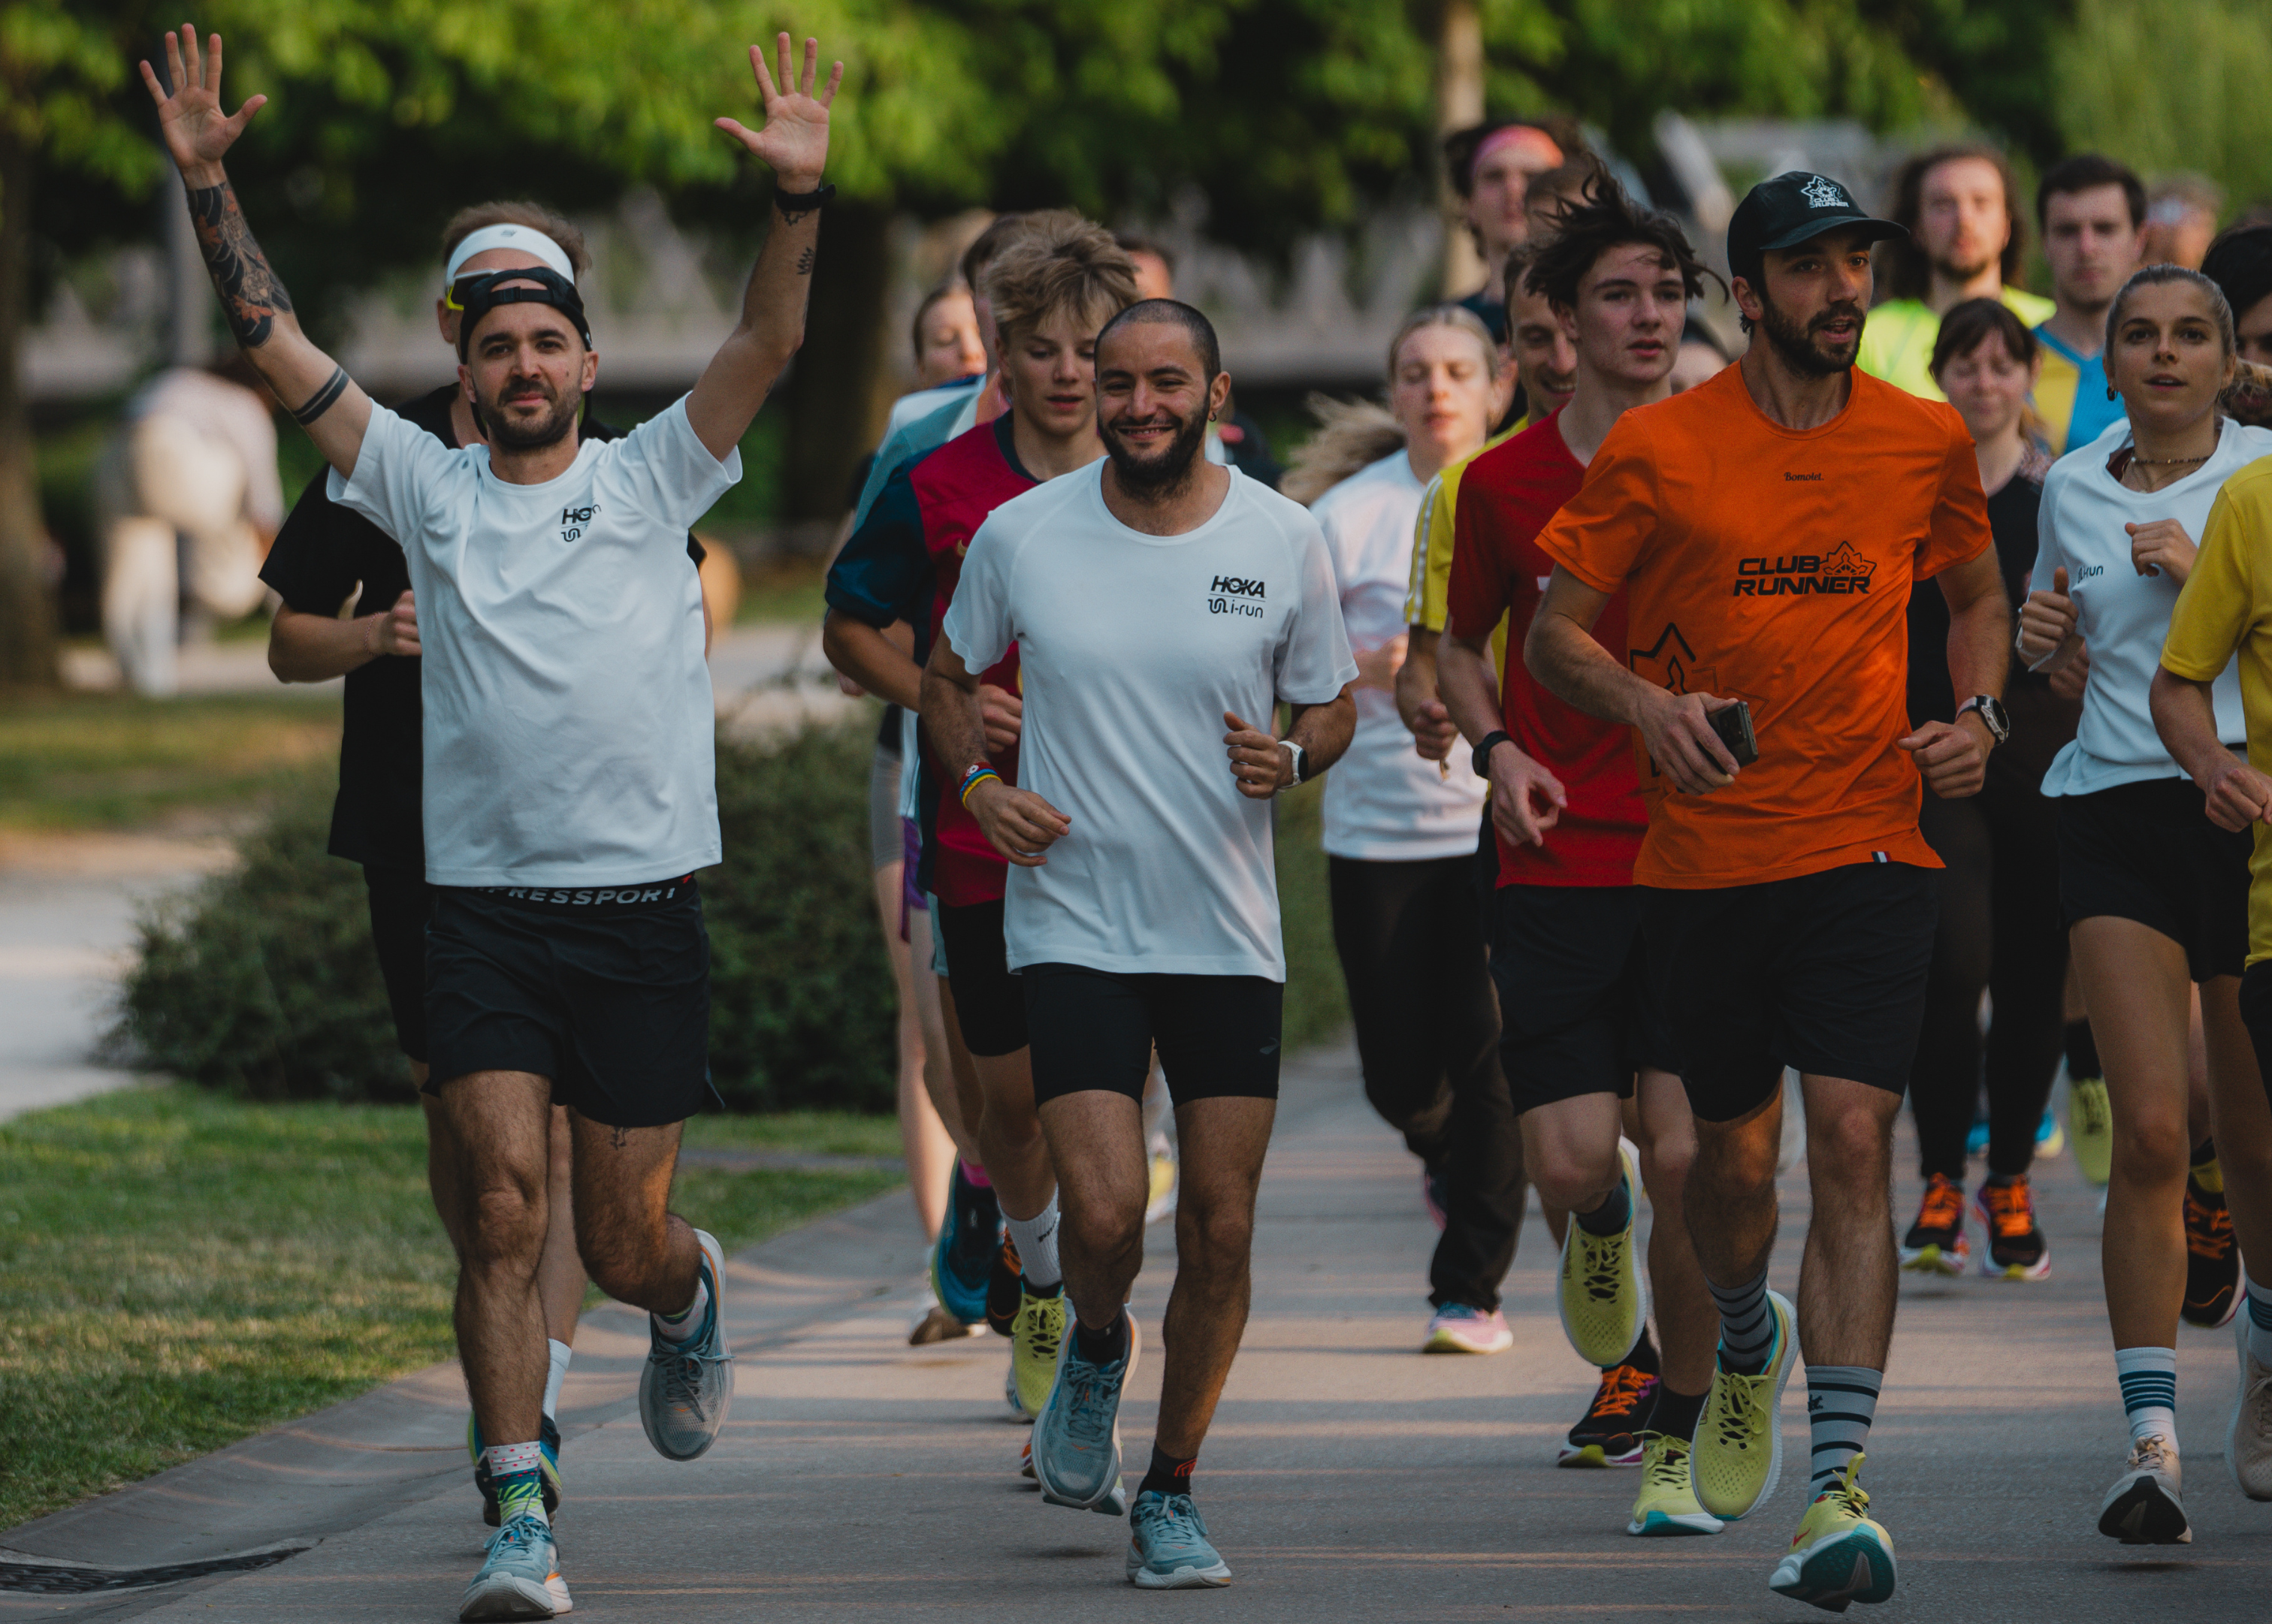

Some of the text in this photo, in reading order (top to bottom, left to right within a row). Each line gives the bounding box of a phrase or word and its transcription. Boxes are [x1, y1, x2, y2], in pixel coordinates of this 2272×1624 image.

[1738, 555, 1820, 576] CLUB
[1210, 575, 1265, 599] HOKA
[1733, 576, 1871, 596] RUNNER
[1231, 599, 1264, 618] i-run
